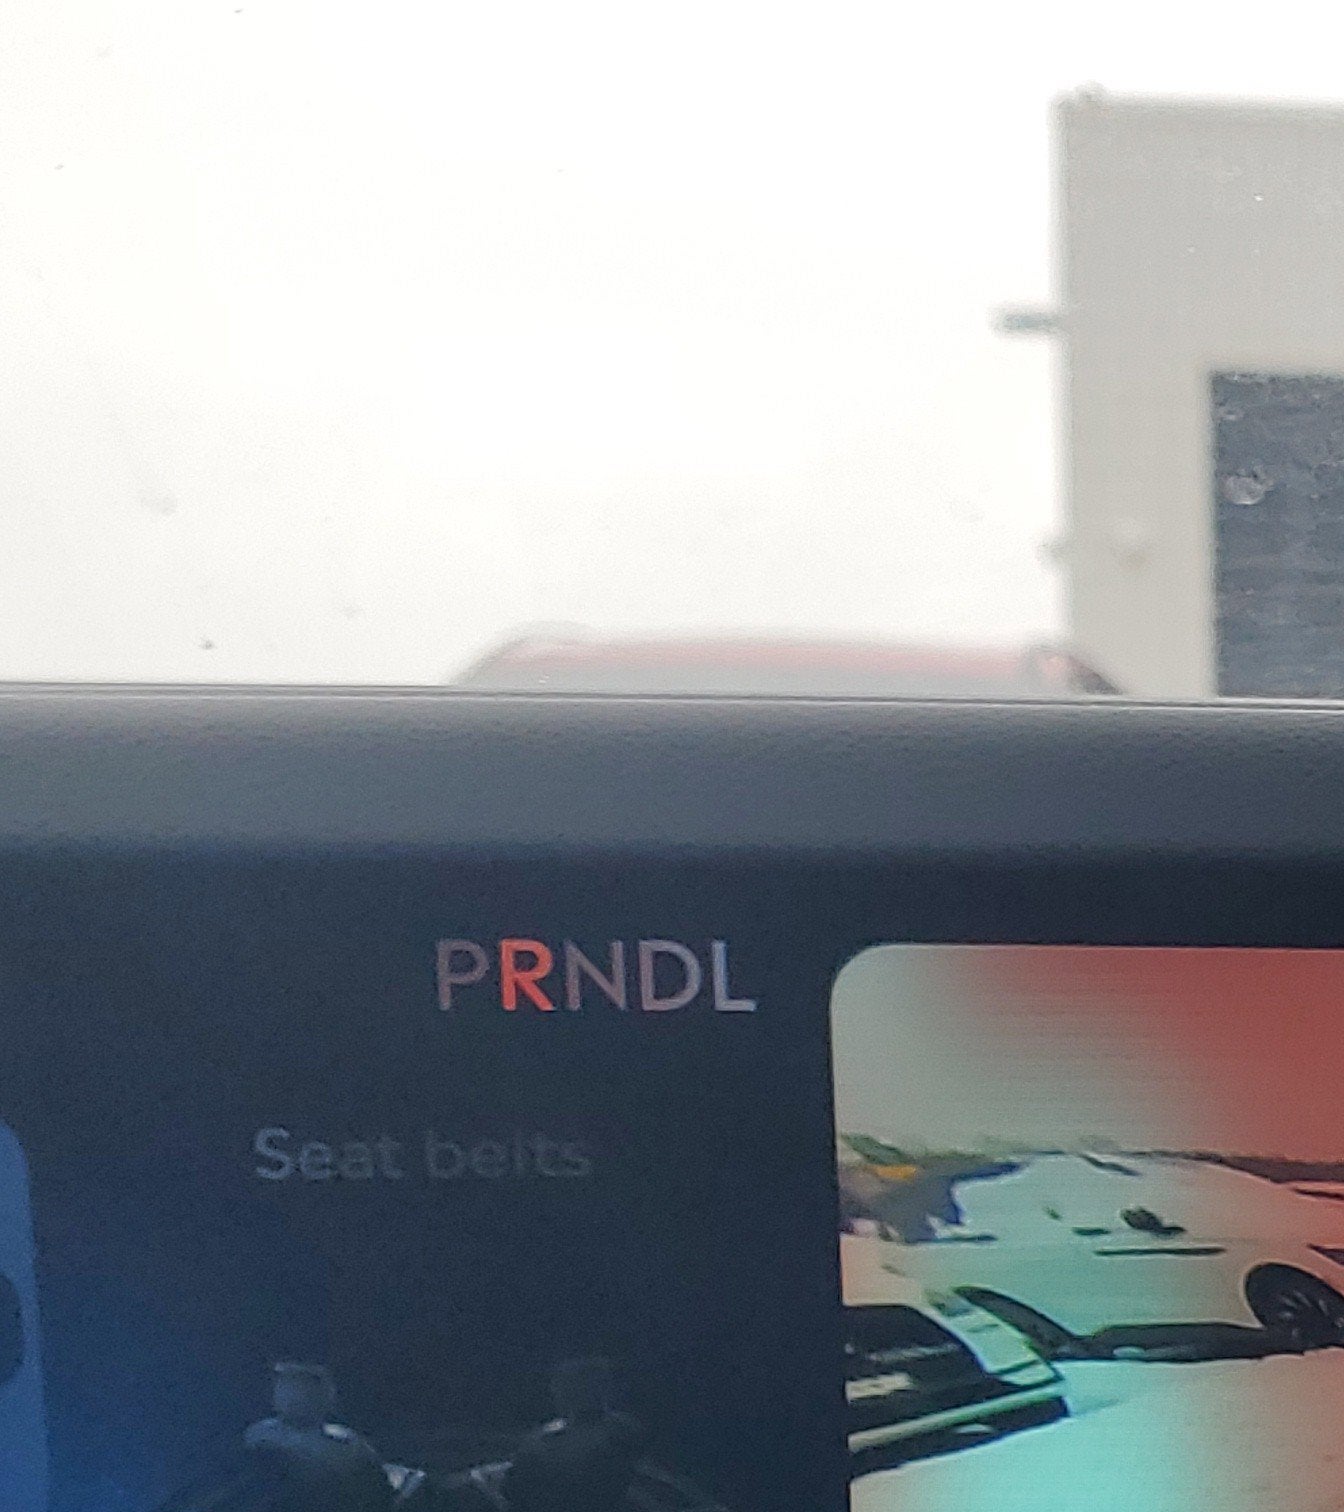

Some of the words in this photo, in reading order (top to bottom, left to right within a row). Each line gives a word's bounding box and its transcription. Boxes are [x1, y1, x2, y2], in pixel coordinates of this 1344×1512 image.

[434, 938, 758, 1013] PRNDL
[252, 1126, 401, 1181] Seat
[424, 1129, 592, 1179] belts
